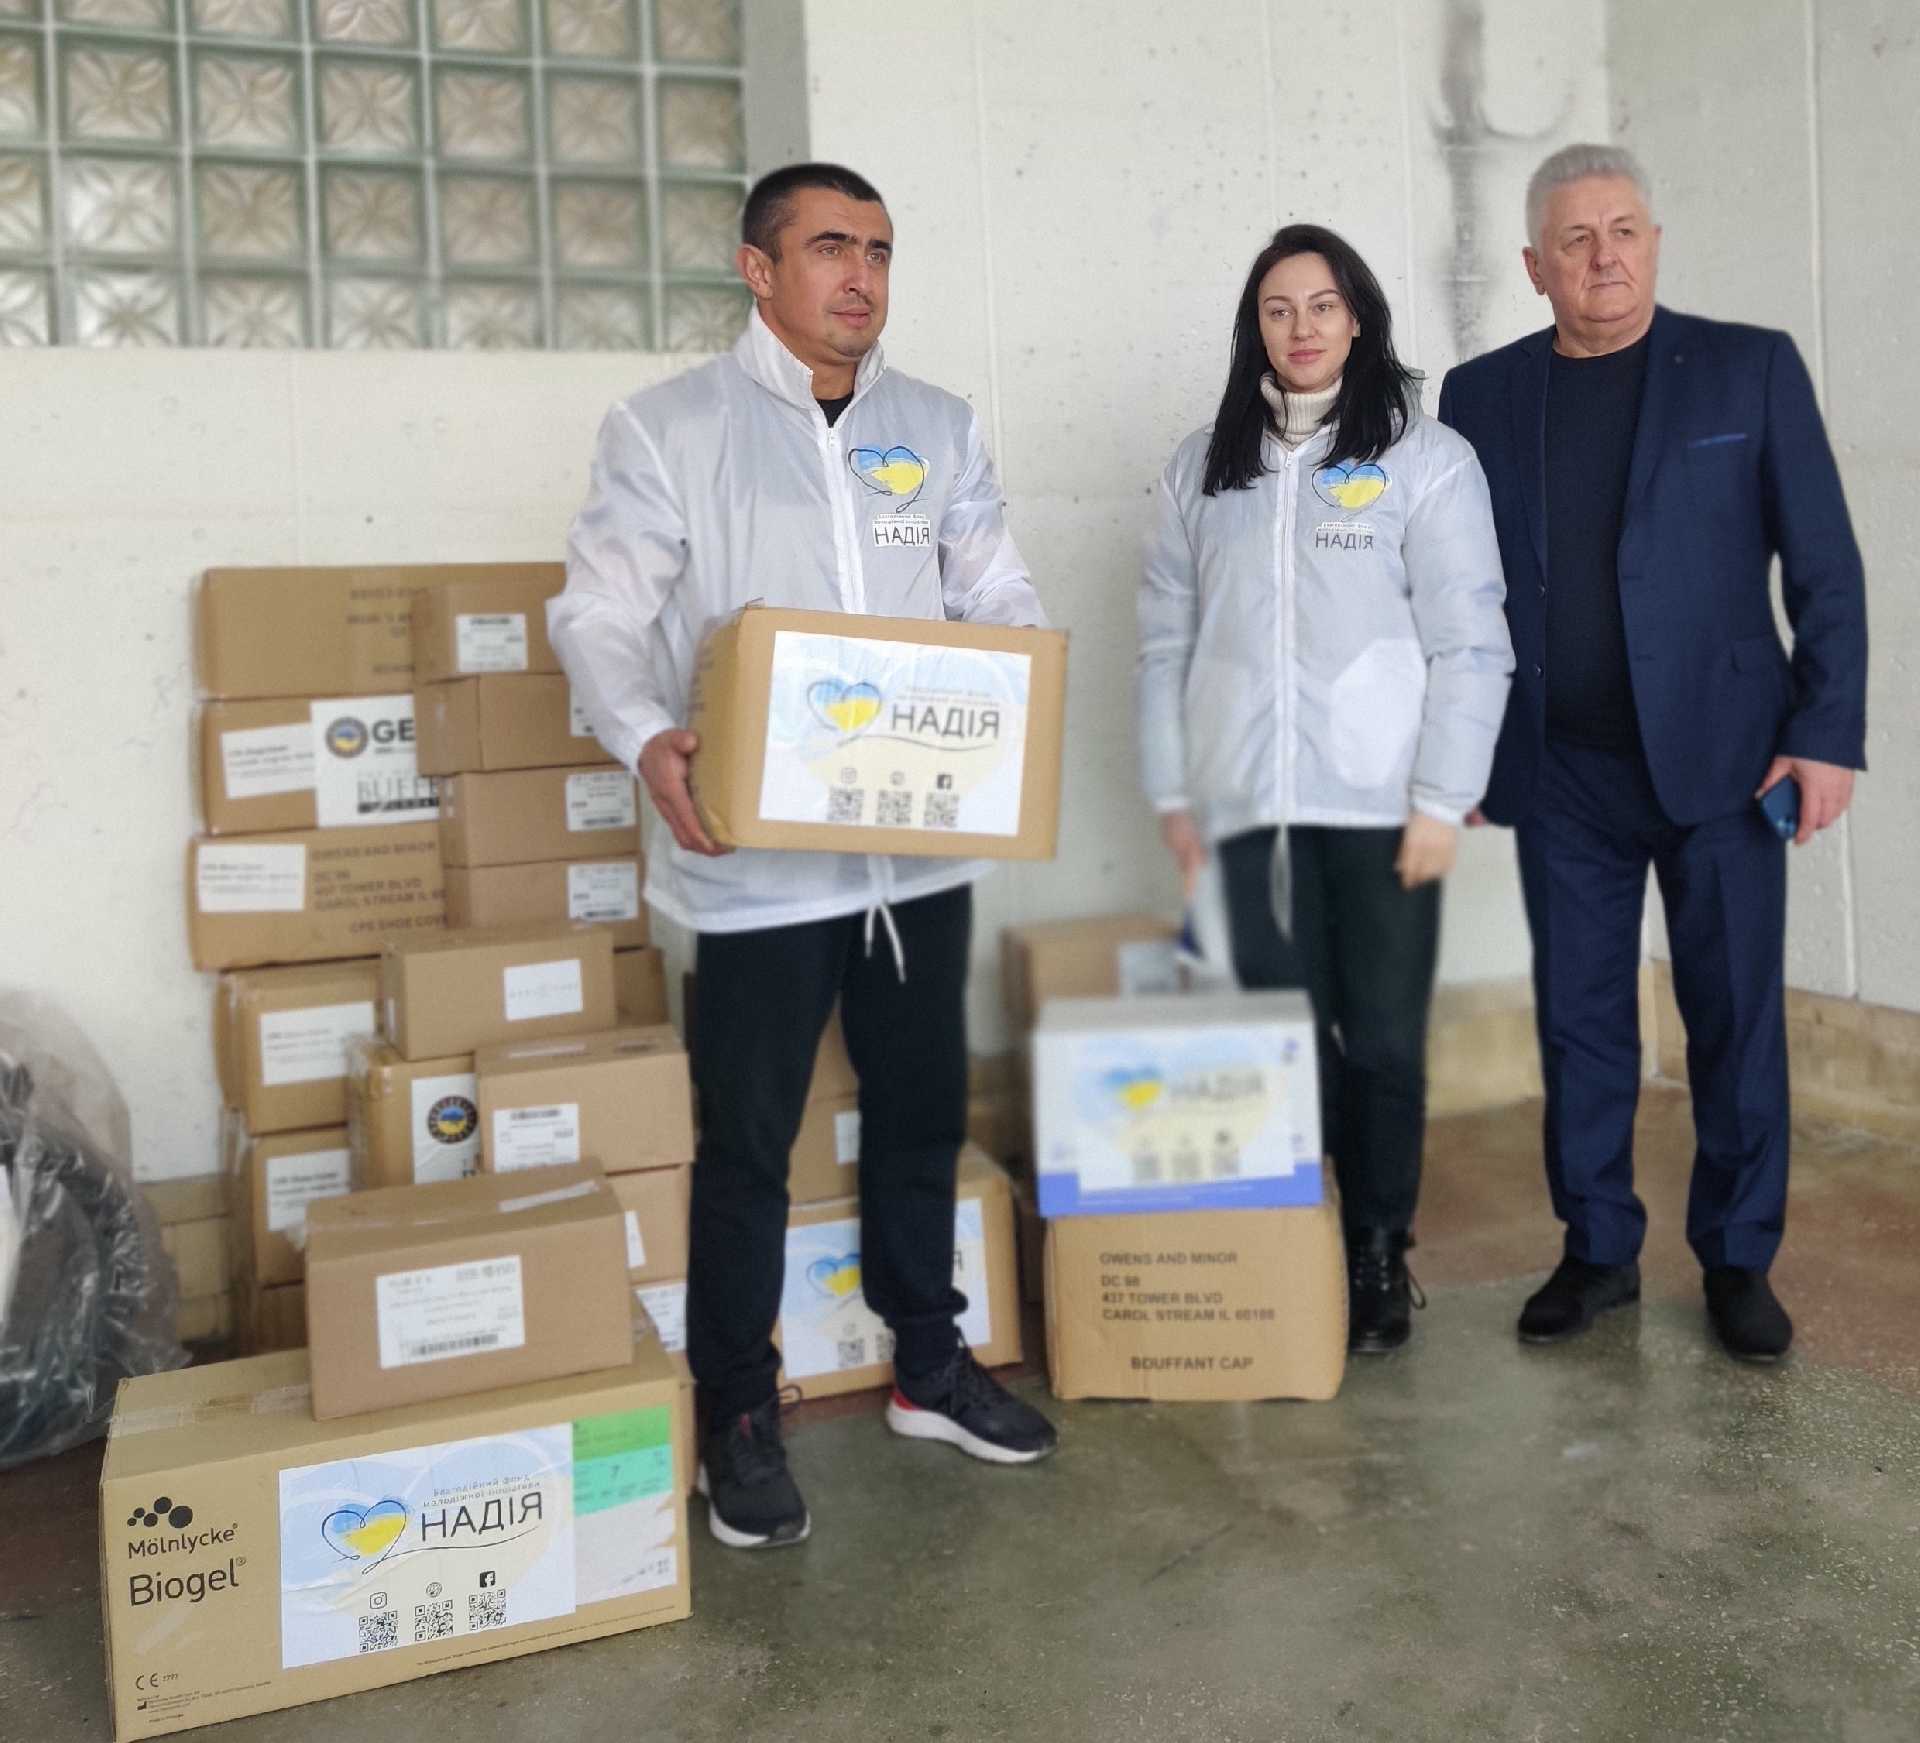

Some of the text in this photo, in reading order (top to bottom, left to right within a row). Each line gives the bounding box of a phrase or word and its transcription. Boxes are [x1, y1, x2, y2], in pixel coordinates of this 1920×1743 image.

[874, 526, 930, 546] НАДІЯ
[1315, 532, 1375, 551] НАДІЯ
[891, 703, 1000, 739] НАДІЯ
[1099, 1252, 1238, 1265] OWENS AND MINOR
[1101, 1276, 1121, 1288] DC
[1128, 1292, 1181, 1304] TOWER
[1184, 1292, 1223, 1304] BLVD
[1103, 1308, 1150, 1321] CAROL
[1156, 1308, 1215, 1321] STREAM
[1219, 1308, 1231, 1321] IL
[1219, 1356, 1254, 1370] CAP
[421, 1491, 543, 1542] НАДІЯ
